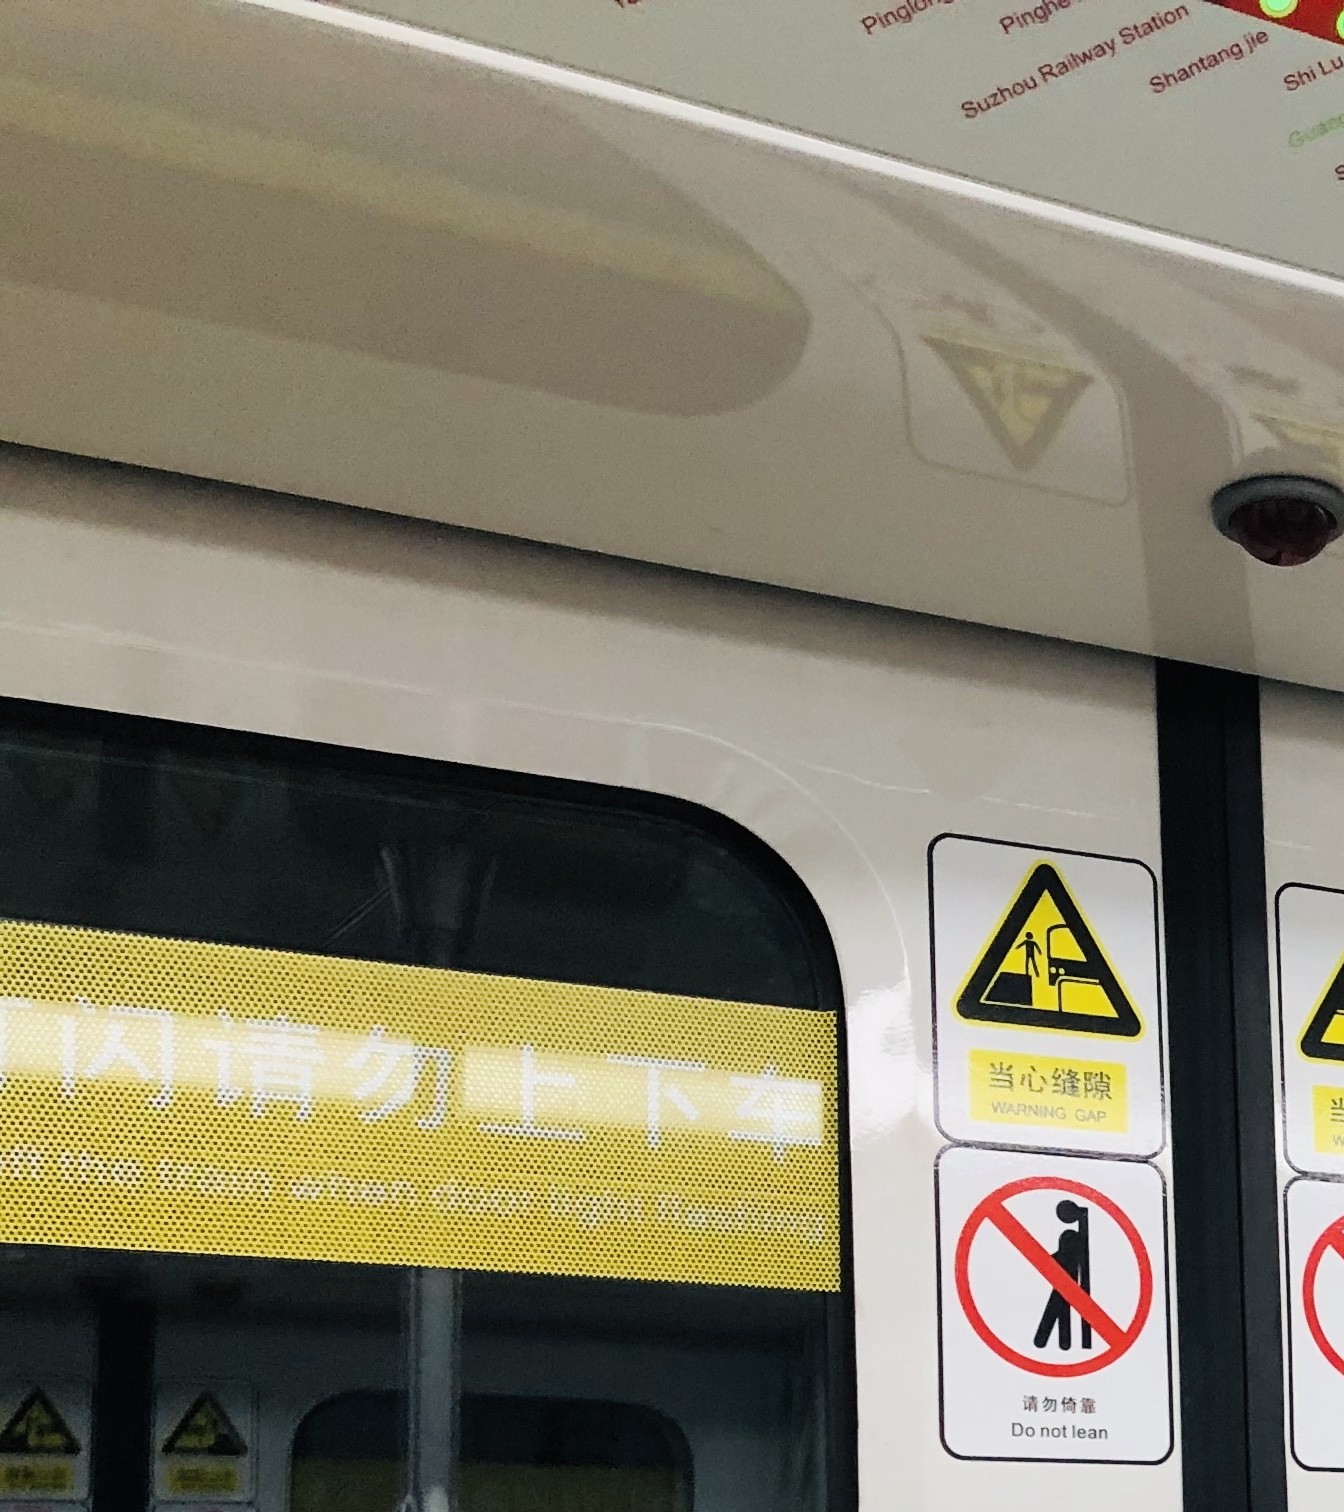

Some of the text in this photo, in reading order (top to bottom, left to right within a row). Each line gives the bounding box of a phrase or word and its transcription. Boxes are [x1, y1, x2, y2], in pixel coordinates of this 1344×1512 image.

[961, 3, 1190, 119] Suzhou Railway Station
[1149, 42, 1245, 94] Shantang
[1283, 55, 1344, 92] Shi Lu
[987, 1061, 1114, 1101] 当心缝隙
[990, 1100, 1108, 1124] WARNING GAP
[1022, 1395, 1097, 1416] 请勿倚靠
[1011, 1422, 1109, 1441] Do not lean
